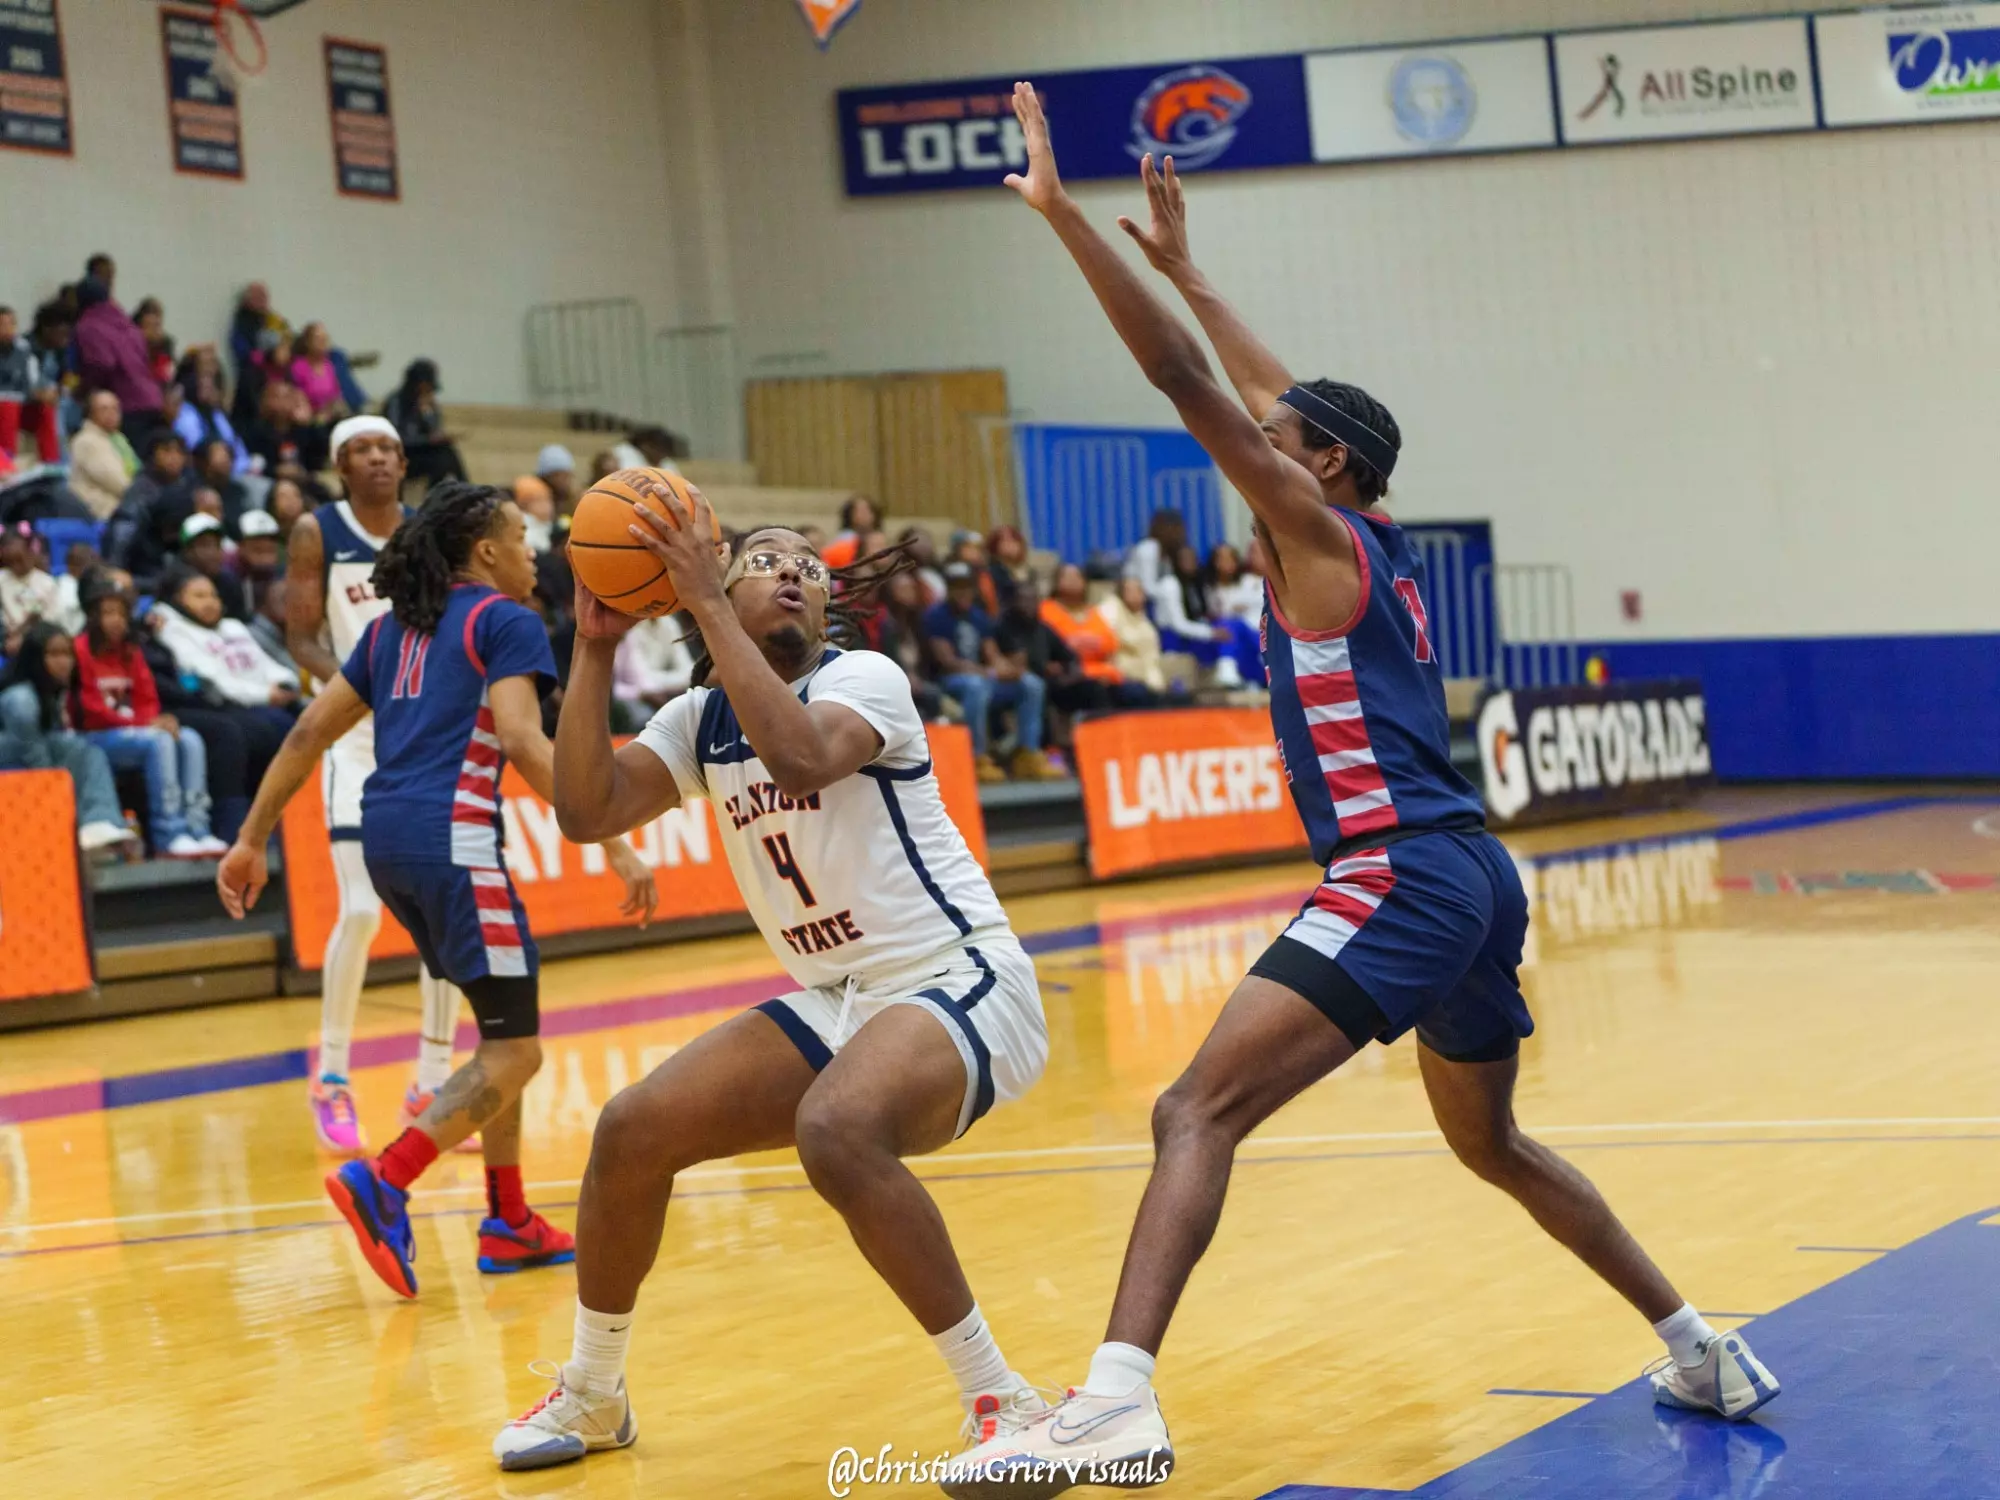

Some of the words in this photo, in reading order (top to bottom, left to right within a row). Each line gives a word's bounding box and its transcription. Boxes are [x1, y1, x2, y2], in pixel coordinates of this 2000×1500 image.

[1527, 694, 1711, 796] GATORADE
[1104, 745, 1283, 830] LAKERS
[761, 831, 818, 909] 4
[780, 909, 865, 956] STATE
